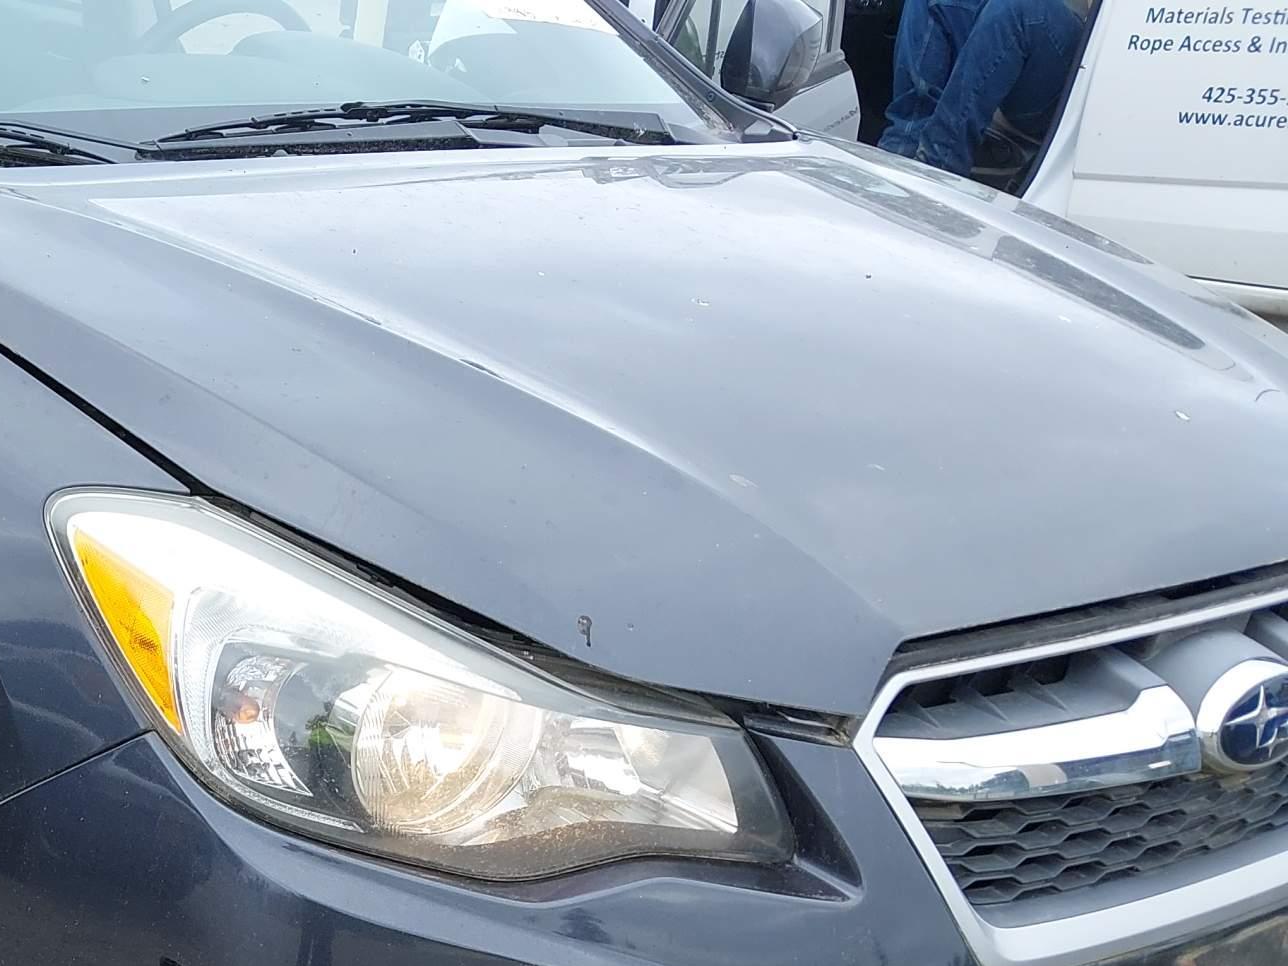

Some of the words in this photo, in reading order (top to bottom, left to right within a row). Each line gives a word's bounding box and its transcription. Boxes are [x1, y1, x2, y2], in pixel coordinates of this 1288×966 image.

[1145, 7, 1235, 25] Materials
[1242, 7, 1288, 25] Testi
[1127, 34, 1174, 55] Rope
[1179, 35, 1242, 53] Access
[1247, 35, 1263, 53] &
[1202, 86, 1288, 106] 425-355-
